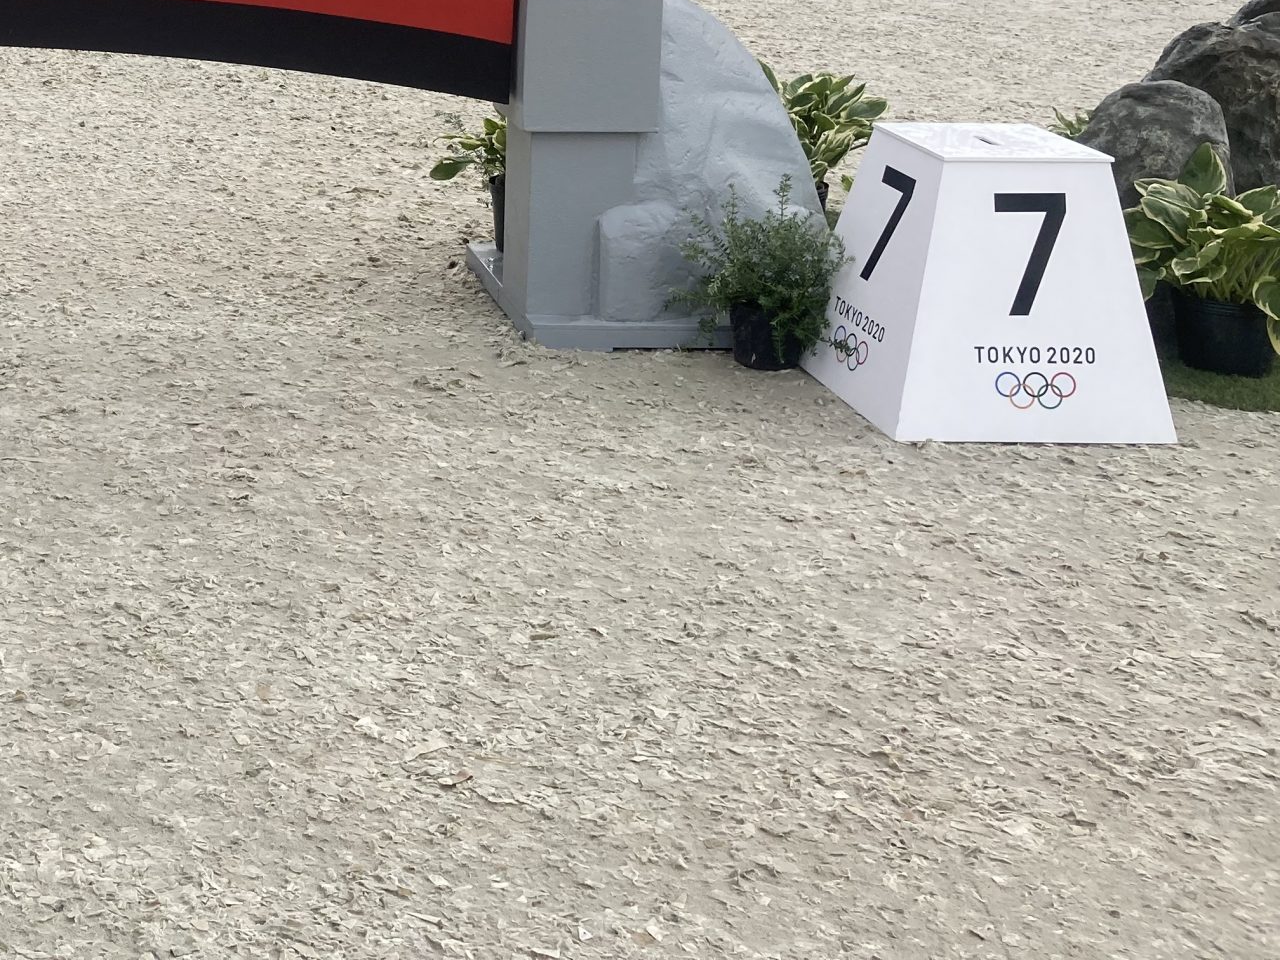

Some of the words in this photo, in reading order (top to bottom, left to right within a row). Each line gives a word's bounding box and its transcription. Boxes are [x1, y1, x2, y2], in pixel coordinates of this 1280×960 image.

[859, 164, 917, 281] 7
[993, 192, 1067, 316] 7
[834, 295, 863, 327] TOKYO
[861, 315, 885, 343] 2020
[973, 346, 1041, 364] TOKYO
[1046, 346, 1096, 365] 2020
